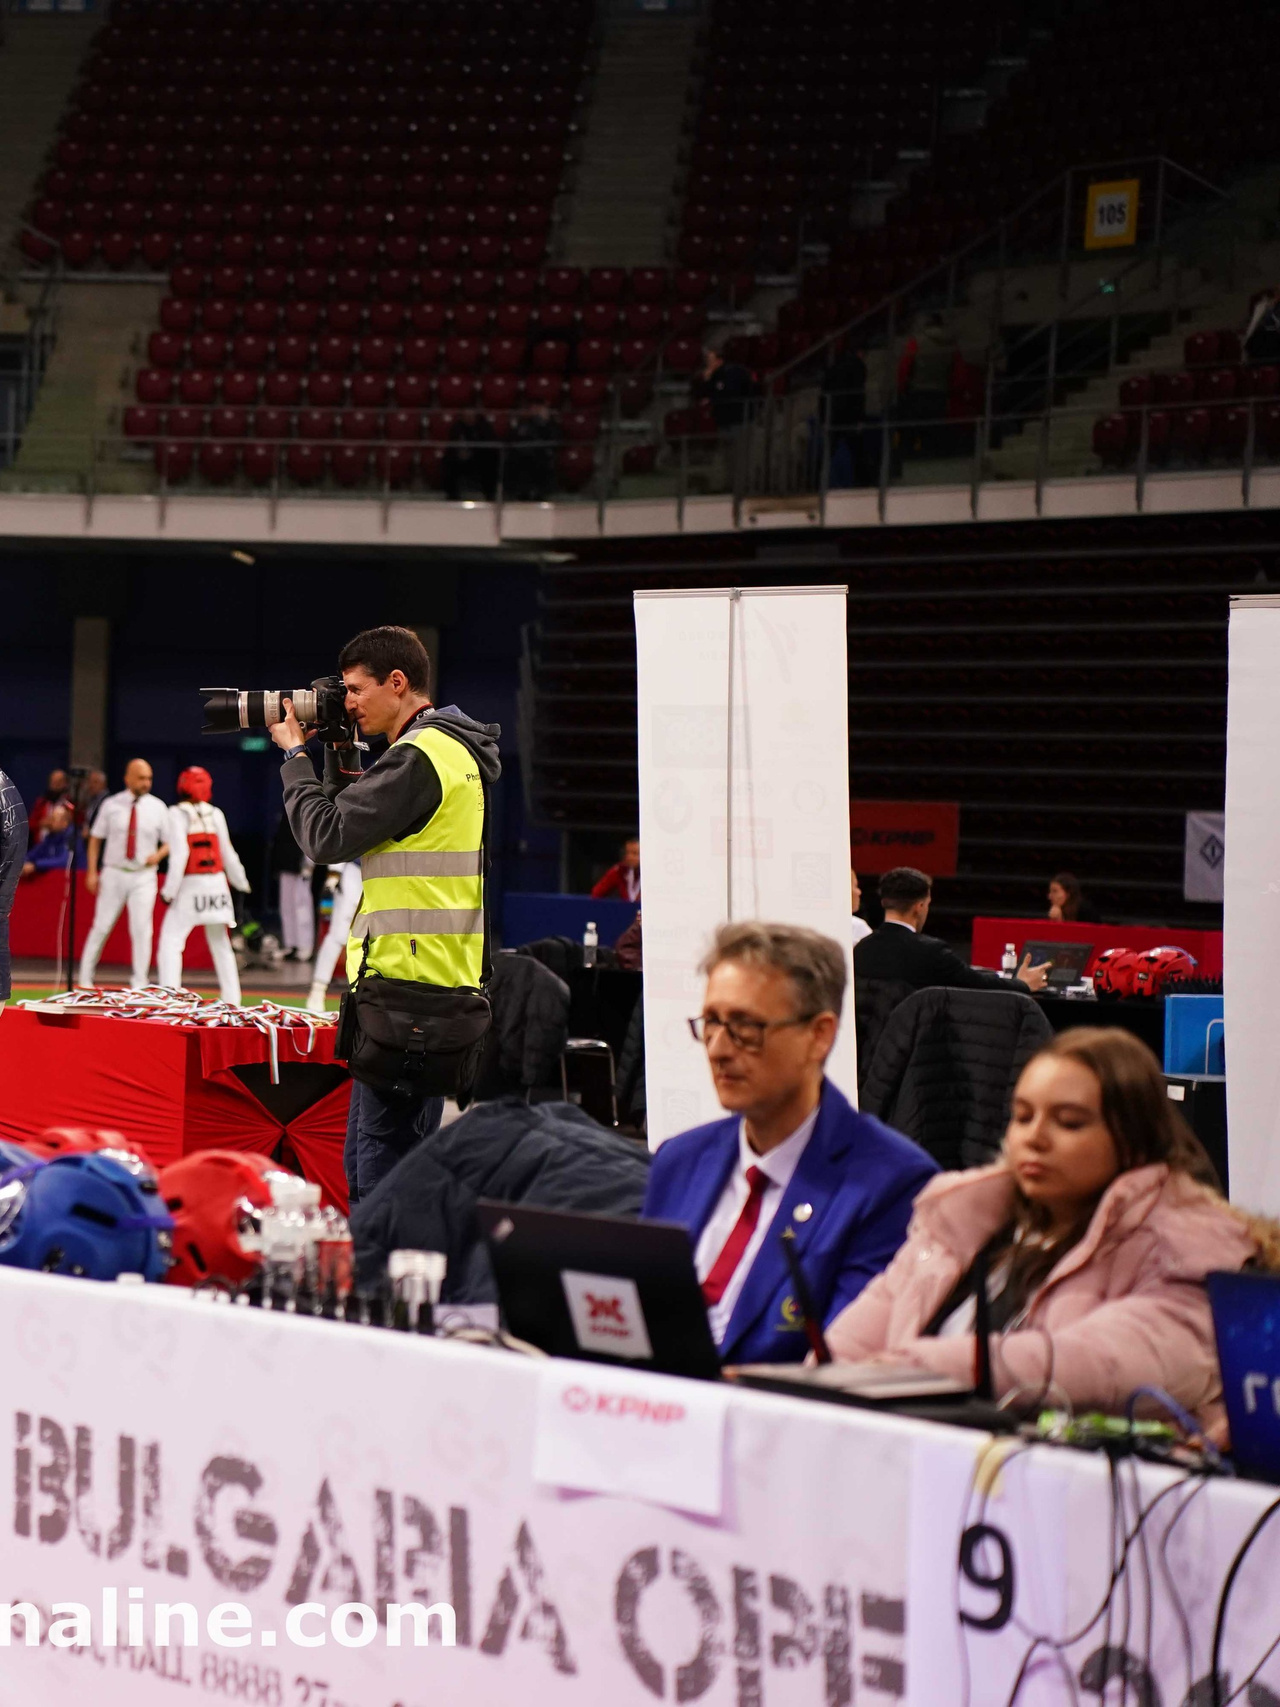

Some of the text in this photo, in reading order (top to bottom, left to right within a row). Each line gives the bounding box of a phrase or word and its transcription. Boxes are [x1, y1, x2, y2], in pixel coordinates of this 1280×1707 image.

[1098, 203, 1126, 226] 105
[194, 894, 232, 912] UKR
[596, 1393, 687, 1423] KPNP
[13, 1410, 579, 1676] BULGARIA
[958, 1522, 1015, 1632] 9
